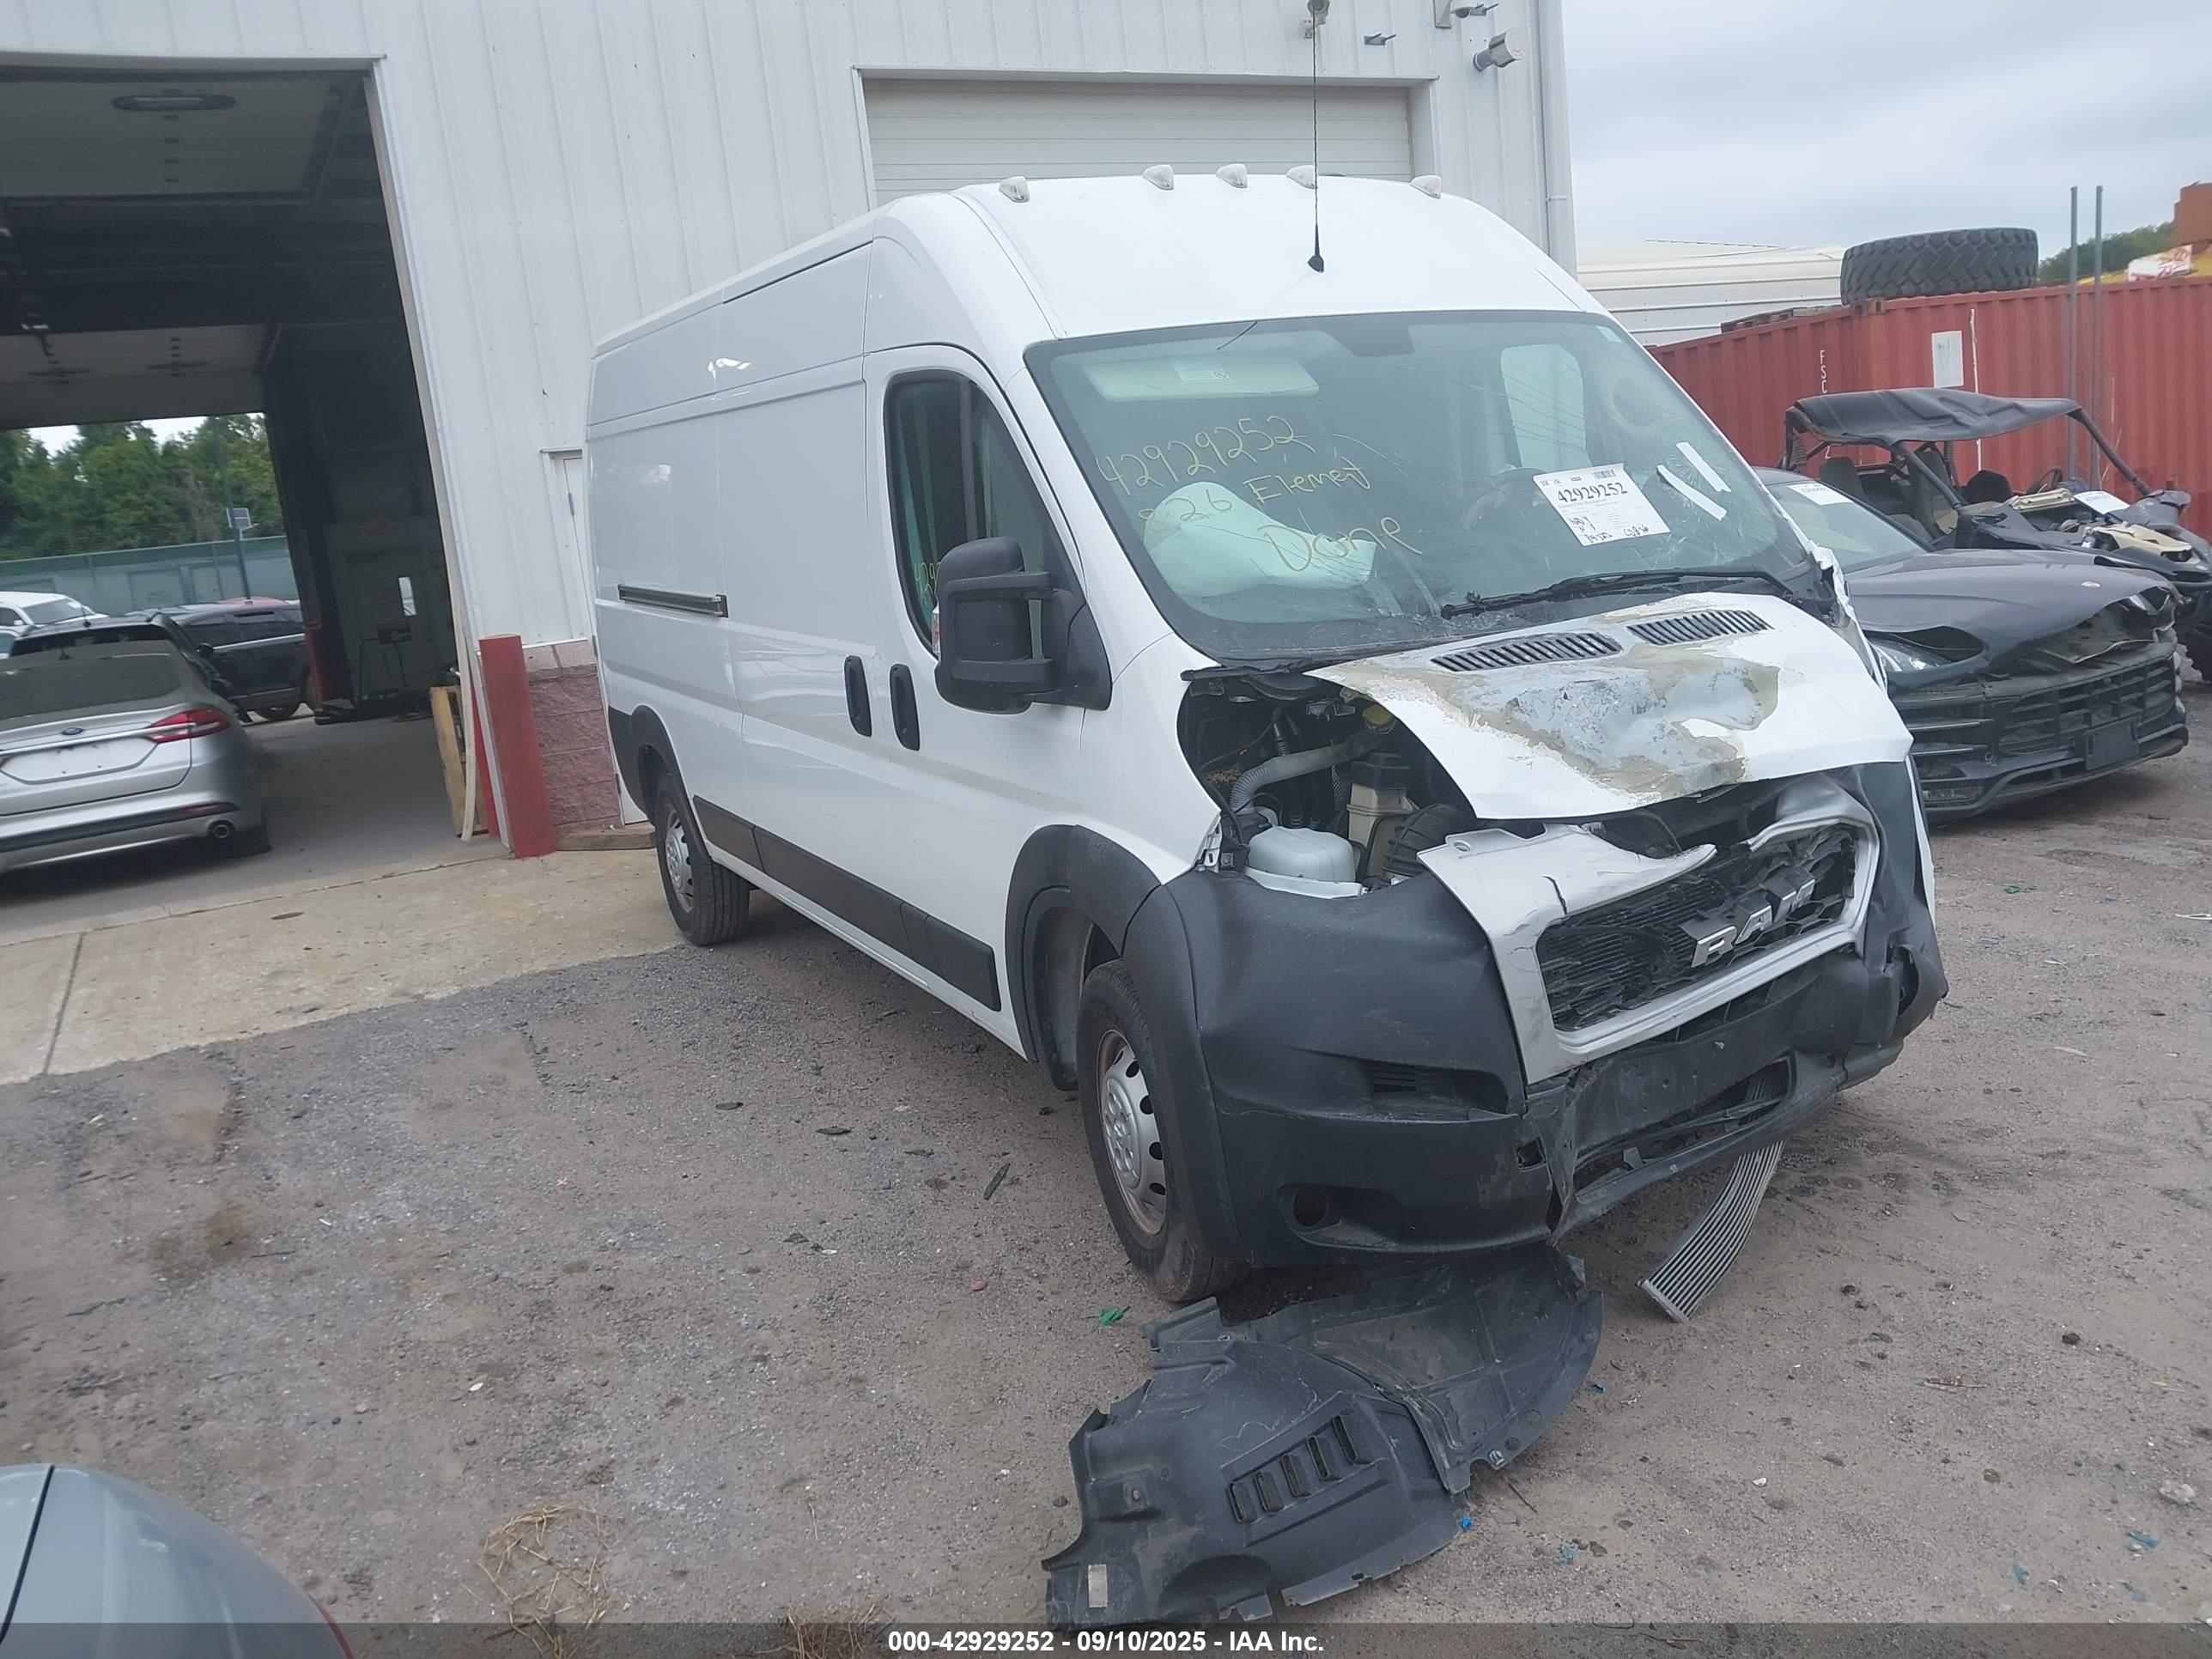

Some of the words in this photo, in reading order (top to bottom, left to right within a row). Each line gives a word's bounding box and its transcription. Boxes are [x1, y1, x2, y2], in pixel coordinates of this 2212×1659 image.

[1095, 415, 1316, 496] 42929252
[1558, 482, 1628, 503] 42929252
[1690, 878, 1816, 969] RAM
